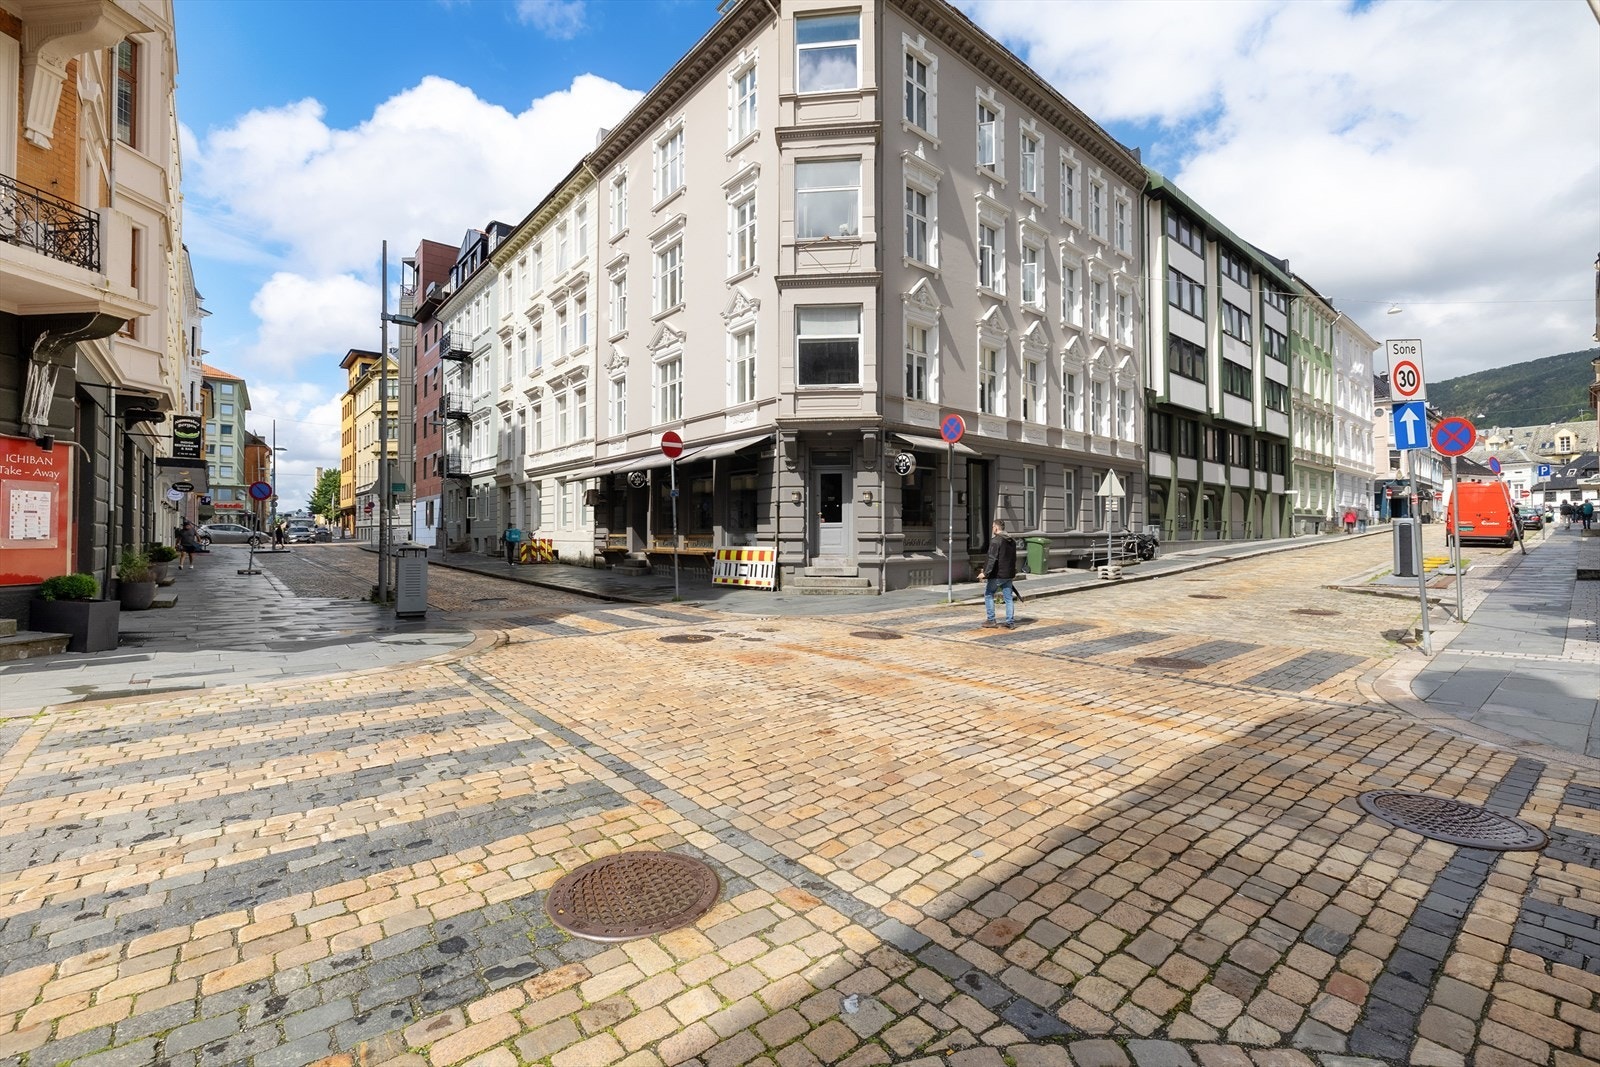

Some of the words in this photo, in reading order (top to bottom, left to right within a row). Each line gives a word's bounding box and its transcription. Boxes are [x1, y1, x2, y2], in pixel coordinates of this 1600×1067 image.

[1393, 344, 1416, 354] Sone
[1399, 370, 1415, 387] 30
[6, 454, 53, 466] ICHIBAN
[0, 466, 22, 476] Take
[33, 468, 60, 480] Away
[1541, 466, 1548, 475] P
